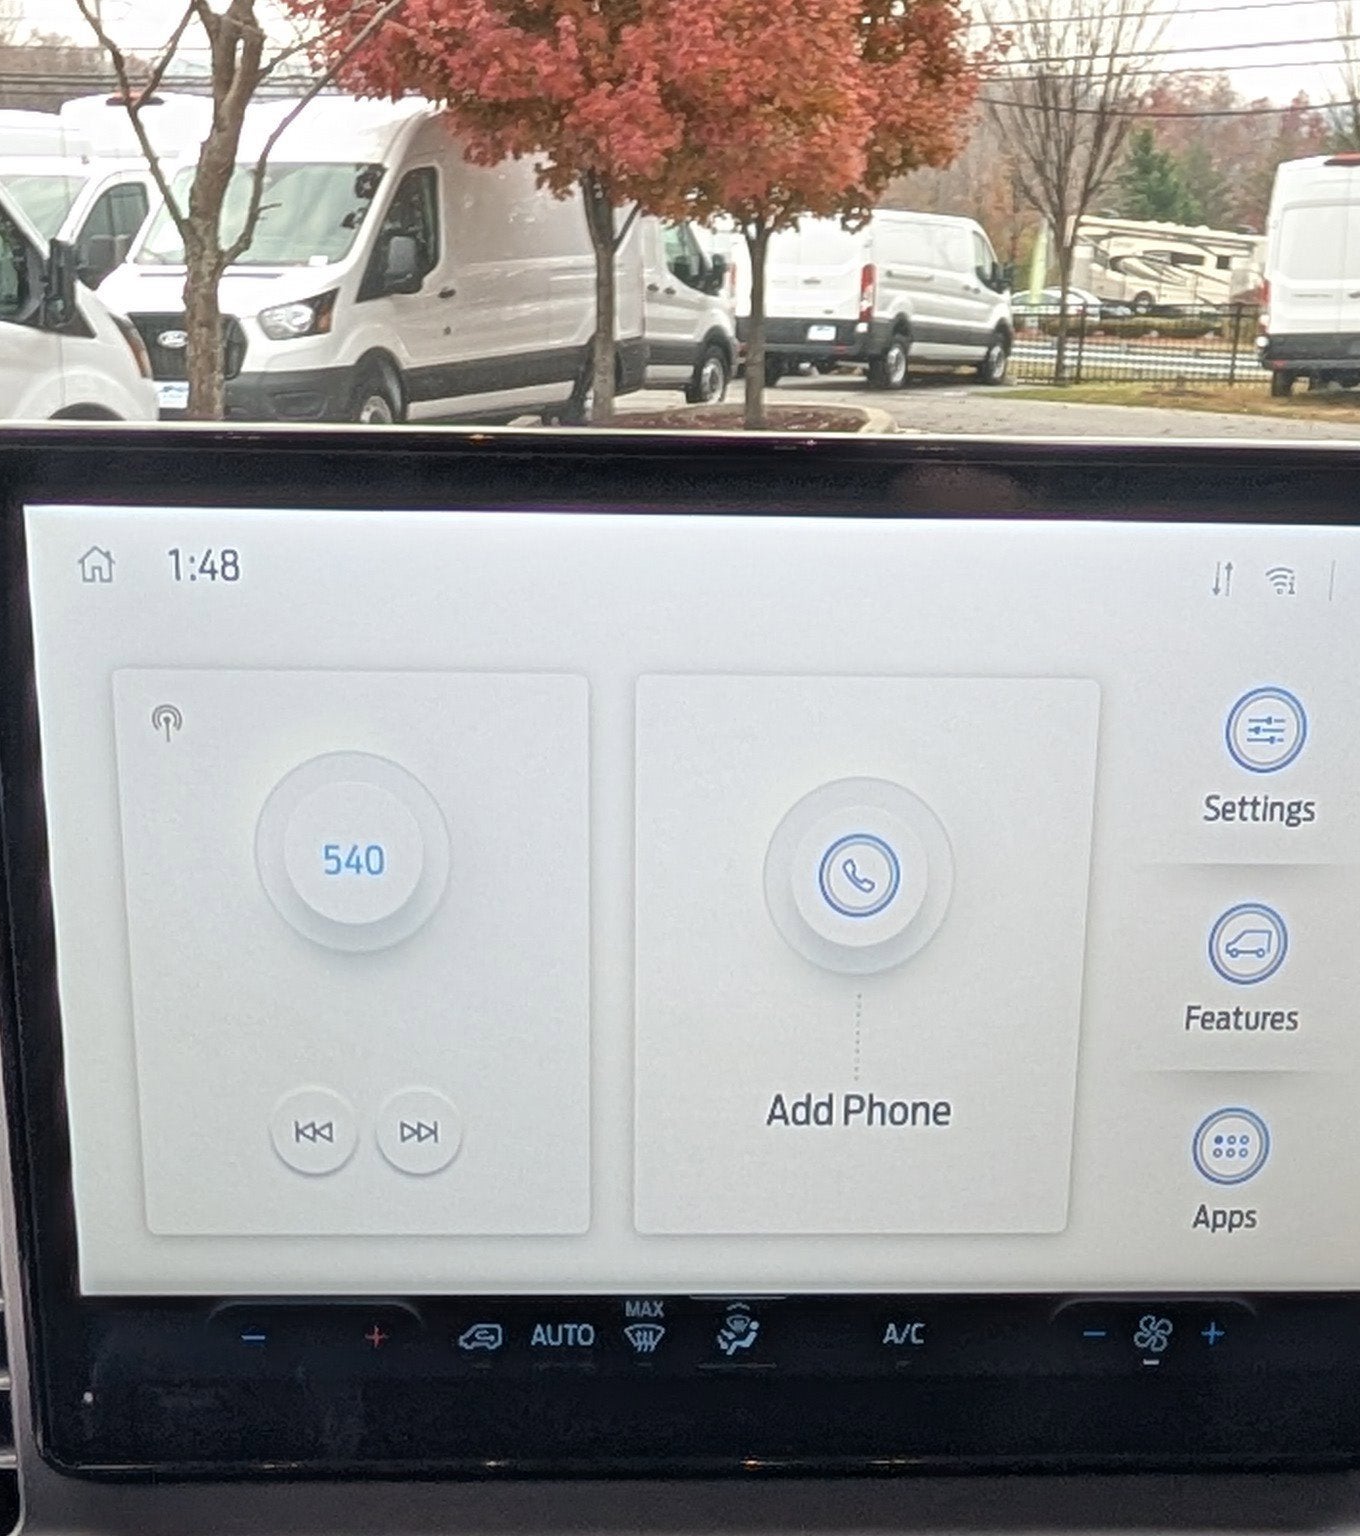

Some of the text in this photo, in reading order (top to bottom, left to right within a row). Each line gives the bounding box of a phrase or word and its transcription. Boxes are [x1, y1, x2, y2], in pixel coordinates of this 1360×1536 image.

[167, 547, 242, 583] 1:48
[1202, 792, 1316, 830] Settings
[322, 843, 385, 878] 540
[1183, 1003, 1299, 1034] Features
[766, 1092, 952, 1130] Add Phone
[1192, 1203, 1257, 1234] Apps
[625, 1302, 664, 1318] MAX
[531, 1324, 595, 1349] AUTO
[882, 1323, 925, 1347] A/C
